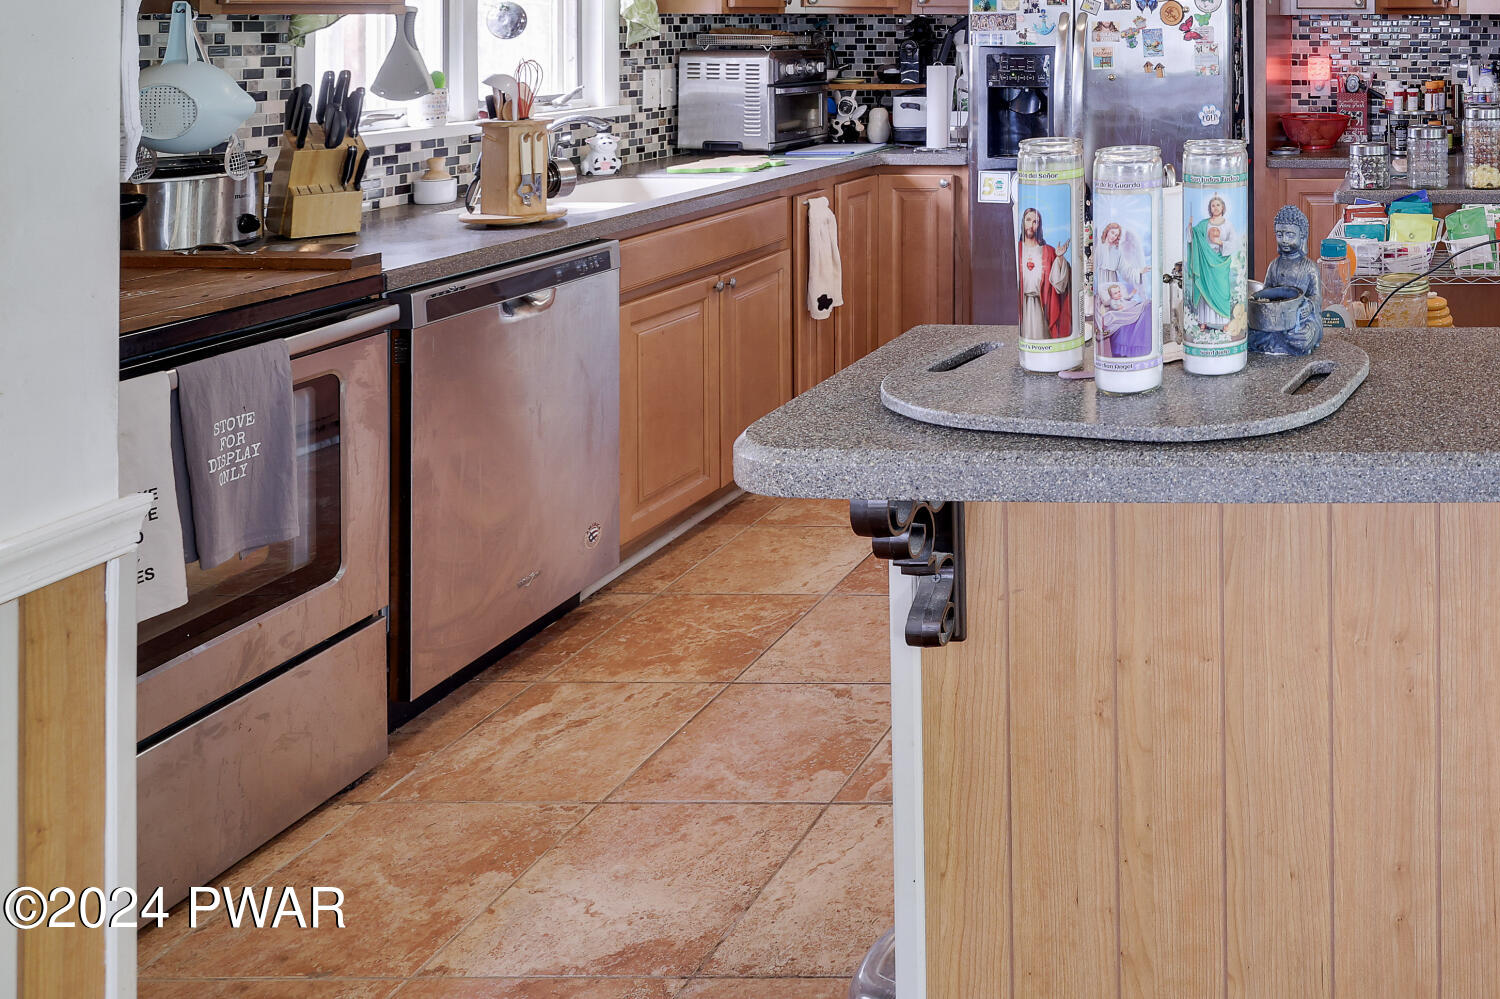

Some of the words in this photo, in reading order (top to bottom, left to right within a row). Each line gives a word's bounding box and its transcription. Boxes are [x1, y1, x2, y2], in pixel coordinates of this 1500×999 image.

[1038, 171, 1059, 179] Señor
[213, 411, 256, 437] STOVE
[220, 431, 246, 451] FOR
[208, 442, 262, 474] DISPLAY
[218, 463, 249, 487] ONLY
